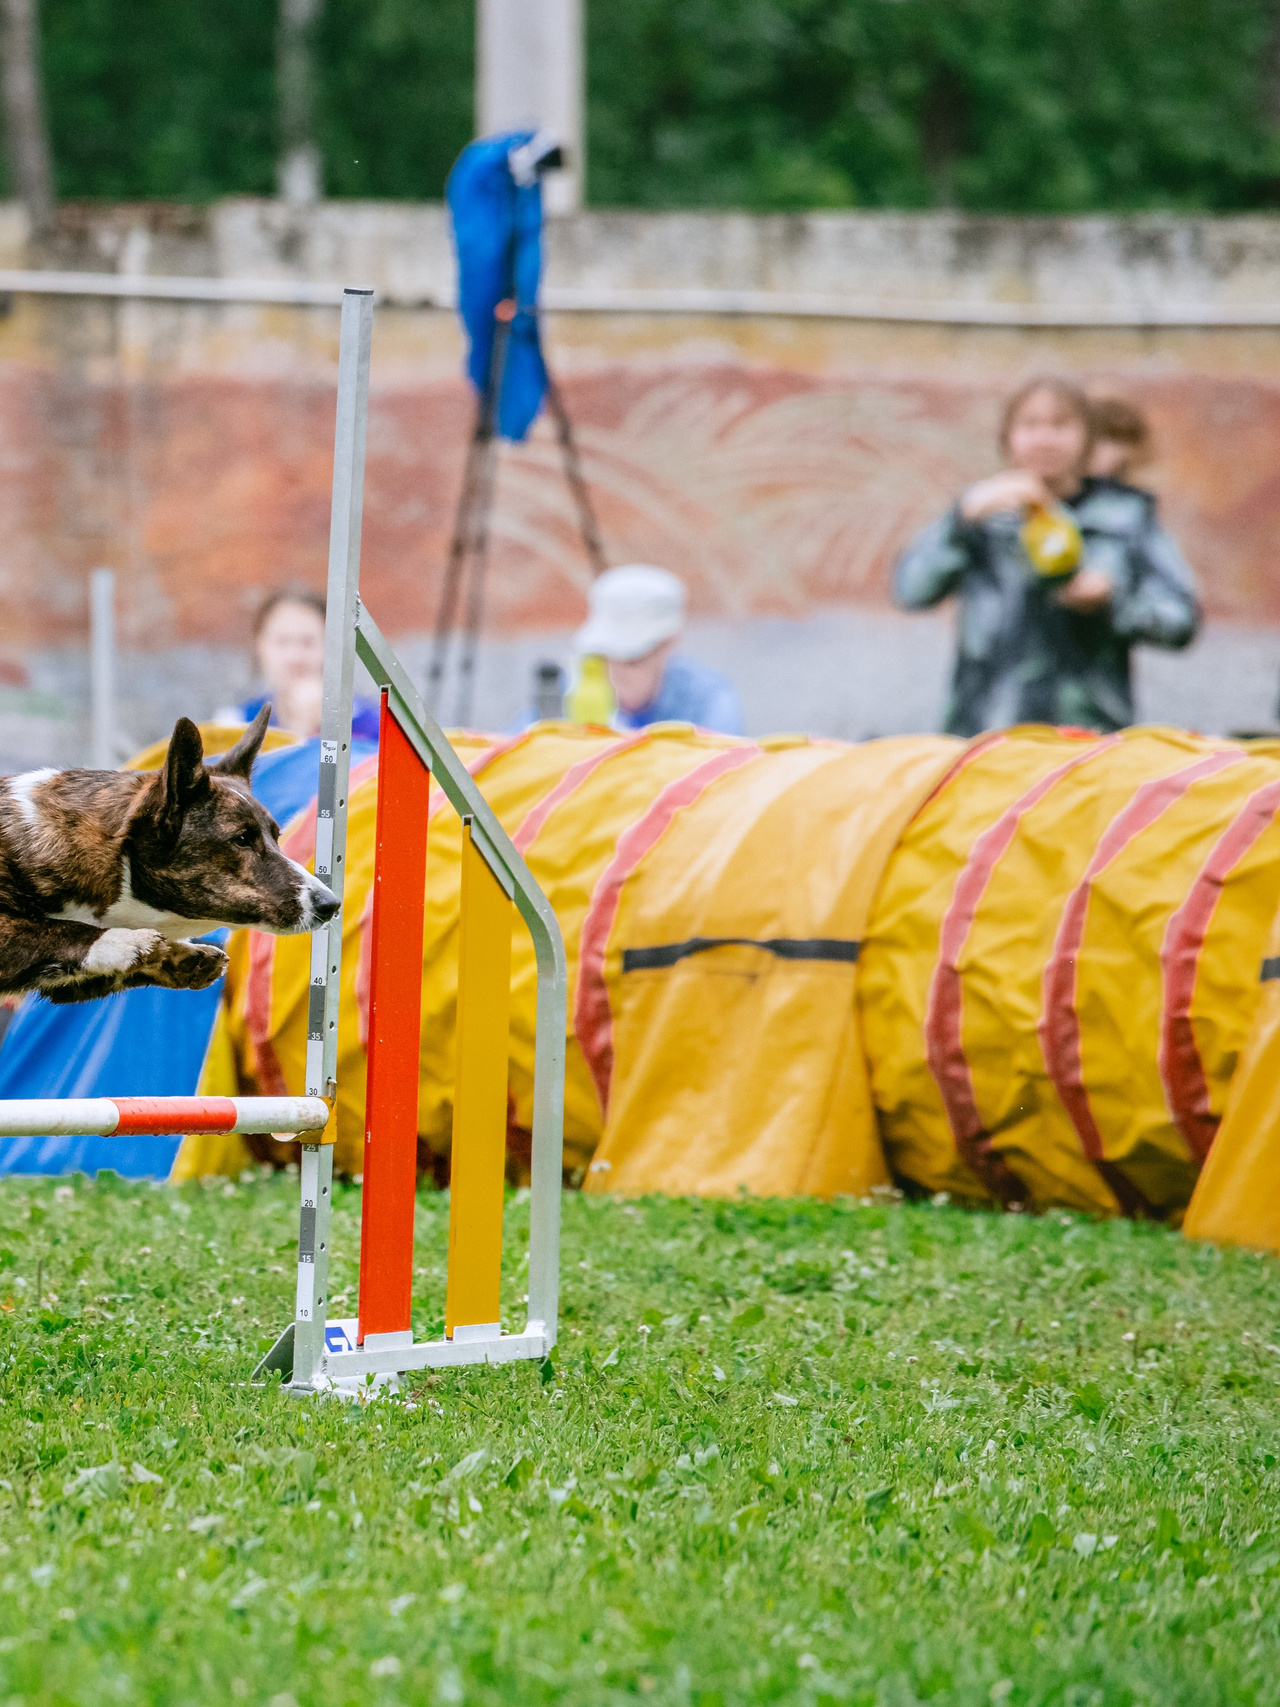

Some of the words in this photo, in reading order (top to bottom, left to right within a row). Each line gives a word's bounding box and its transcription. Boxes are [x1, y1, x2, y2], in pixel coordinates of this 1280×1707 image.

[324, 754, 333, 763] 60
[321, 809, 330, 818] 55
[318, 865, 327, 874] 50
[314, 977, 322, 985] 40
[311, 1032, 320, 1040] 35
[309, 1087, 318, 1095] 30
[304, 1199, 313, 1207] 20
[302, 1254, 311, 1263] 15
[300, 1309, 308, 1317] 10
